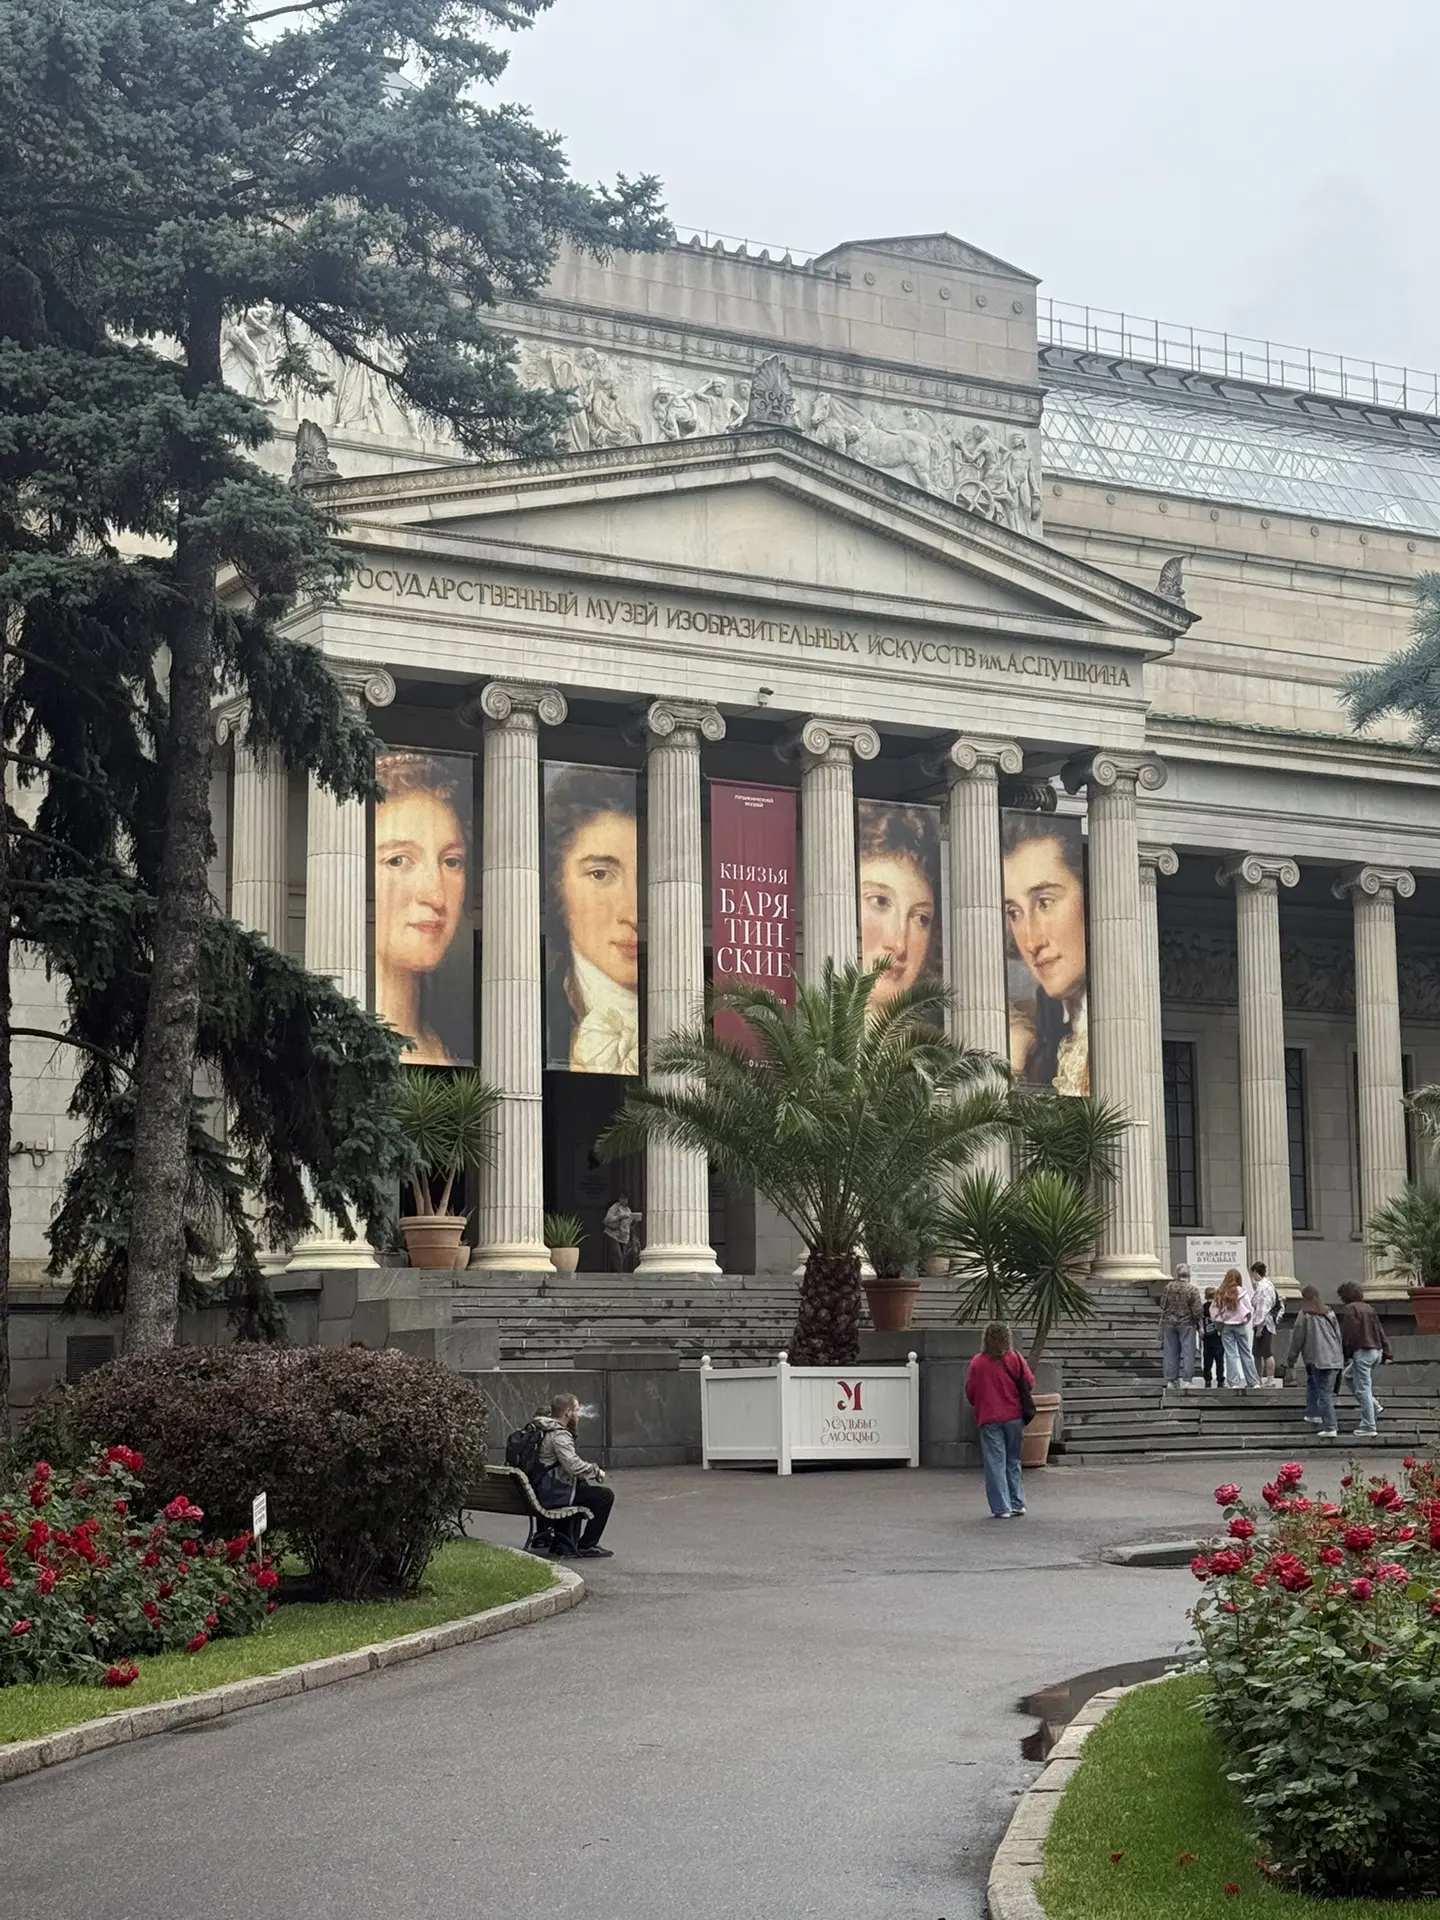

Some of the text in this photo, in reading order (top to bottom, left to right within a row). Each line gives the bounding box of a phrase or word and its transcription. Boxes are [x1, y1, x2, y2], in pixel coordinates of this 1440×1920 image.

[350, 567, 579, 617] ОСУДАРСТВЕННЫЙ
[585, 596, 659, 627] МУЗЕЙ
[666, 606, 859, 653] ИЗОБРАЗИТЕЛЬНЫХ
[867, 634, 977, 668] ИСКУССТВ
[720, 862, 788, 885] КНЯЗЬЯ
[720, 887, 795, 919] БАРЯ-
[724, 917, 790, 948] ТИН-
[717, 946, 792, 978] СКИЕ
